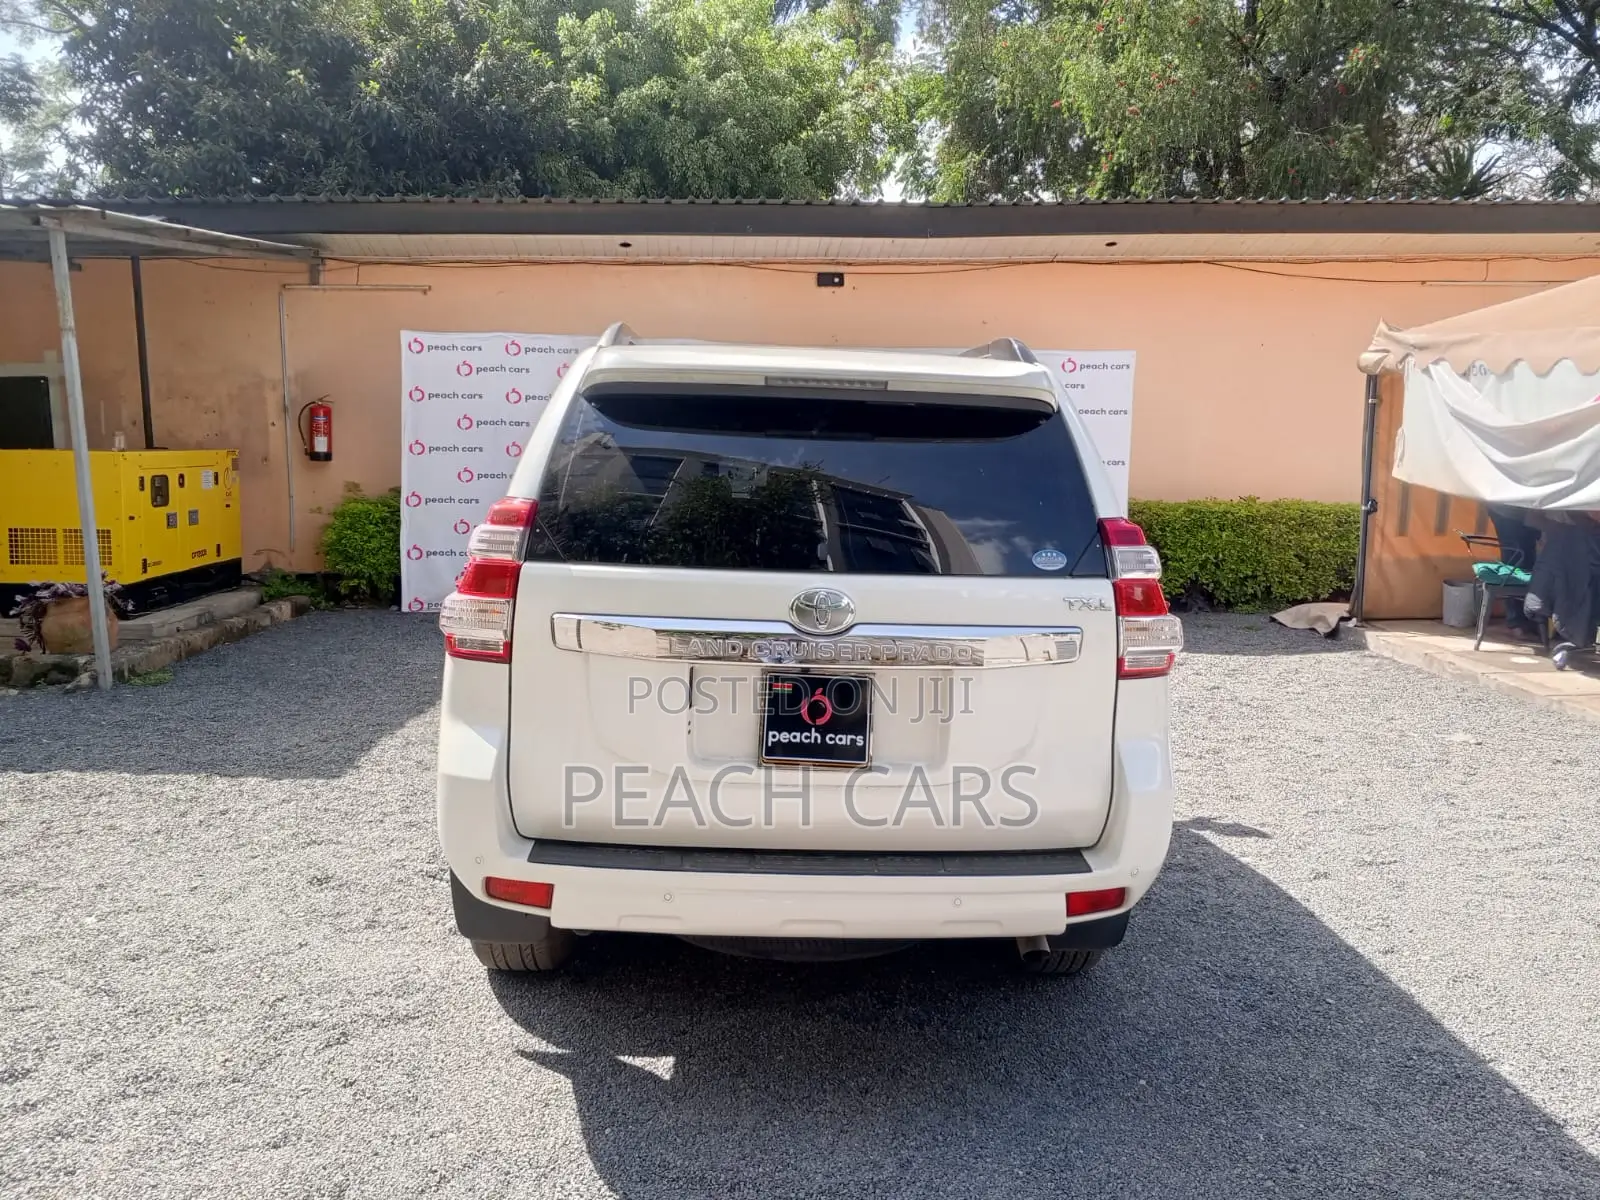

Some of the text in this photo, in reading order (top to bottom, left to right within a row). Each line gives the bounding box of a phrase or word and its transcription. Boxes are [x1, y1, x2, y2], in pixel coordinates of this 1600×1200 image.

[427, 343, 483, 353] peach cars
[524, 345, 580, 355] peach cars
[476, 364, 530, 375] peach cars
[1079, 362, 1108, 371] peach
[428, 391, 483, 400] peach cars
[476, 418, 530, 429] peach cars
[428, 444, 483, 454] peach cars
[477, 471, 507, 481] peach
[424, 496, 456, 505] peach
[426, 548, 457, 558] peach
[669, 636, 973, 661] LAND CRUISER PRADO
[768, 727, 864, 747] peach cars
